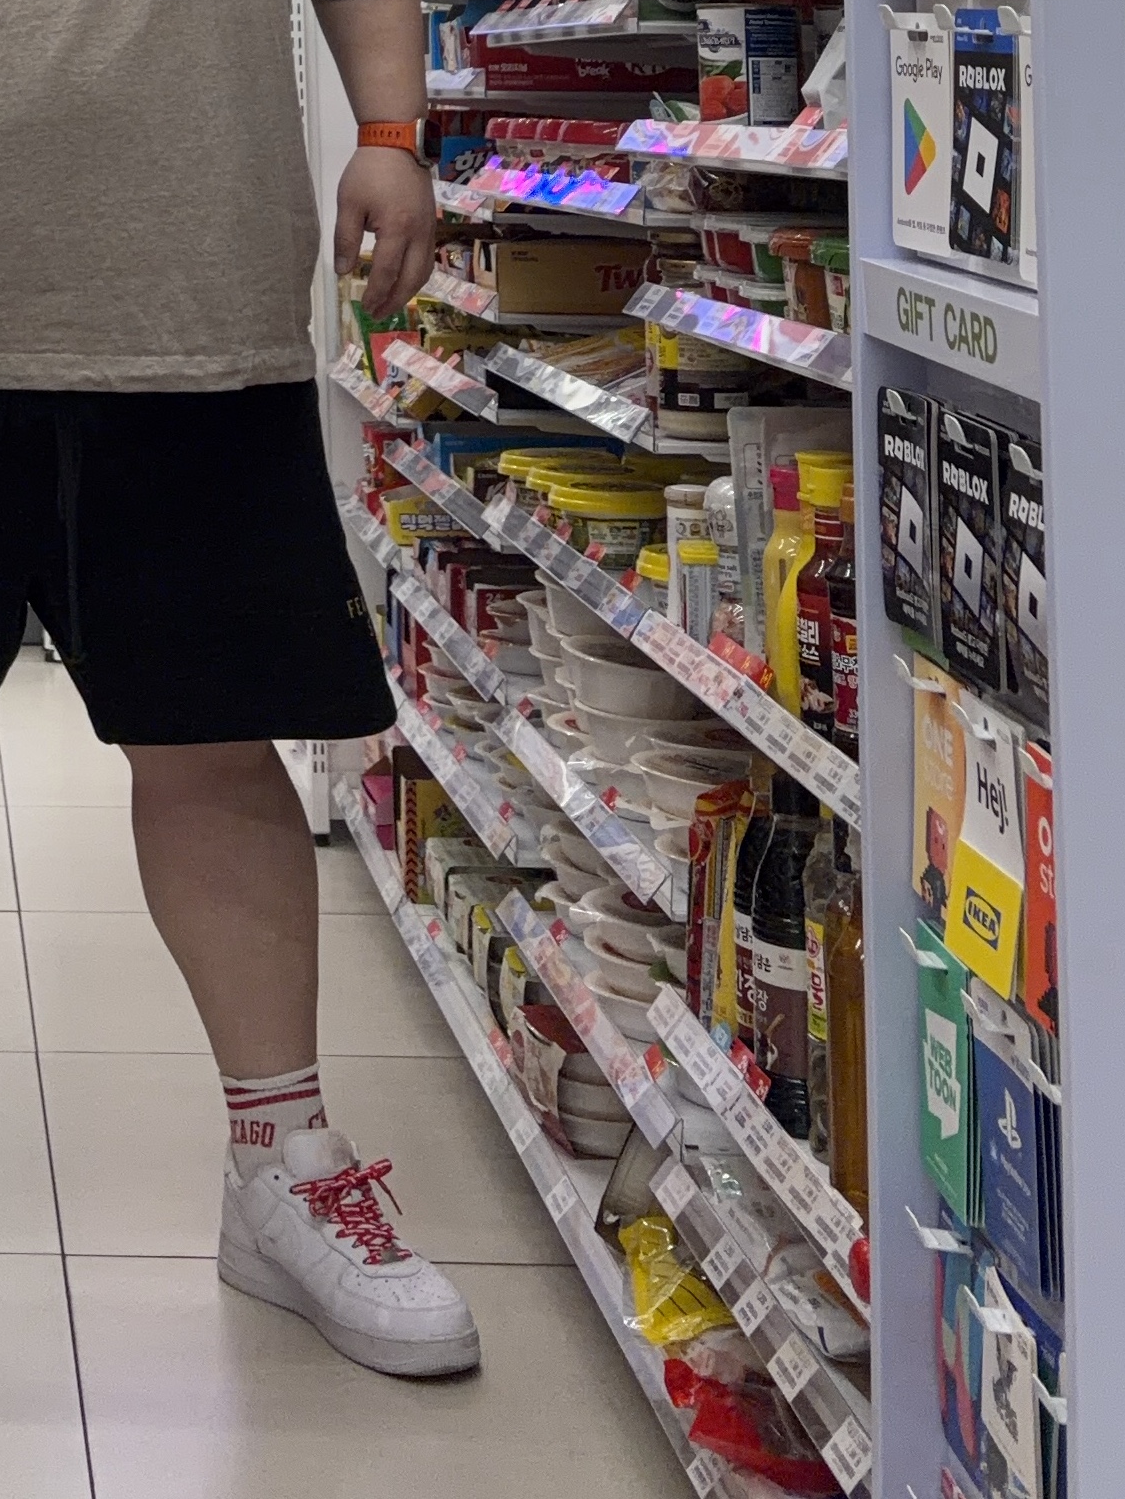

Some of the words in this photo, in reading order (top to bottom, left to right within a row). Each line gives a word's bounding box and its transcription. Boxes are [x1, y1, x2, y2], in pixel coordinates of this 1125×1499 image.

[895, 55, 924, 83] Google
[925, 58, 943, 85] Play
[959, 65, 1006, 91] ROBLOX
[1024, 64, 1032, 87] G
[897, 286, 936, 342] GIFT
[944, 302, 997, 364] CARD
[942, 460, 989, 505] ROBLOX
[976, 761, 1009, 834] Hej!
[1038, 816, 1052, 857] O
[1039, 862, 1055, 899] St
[967, 899, 998, 936] IKEA
[931, 1031, 952, 1080] WEB
[928, 1060, 957, 1113] TOON
